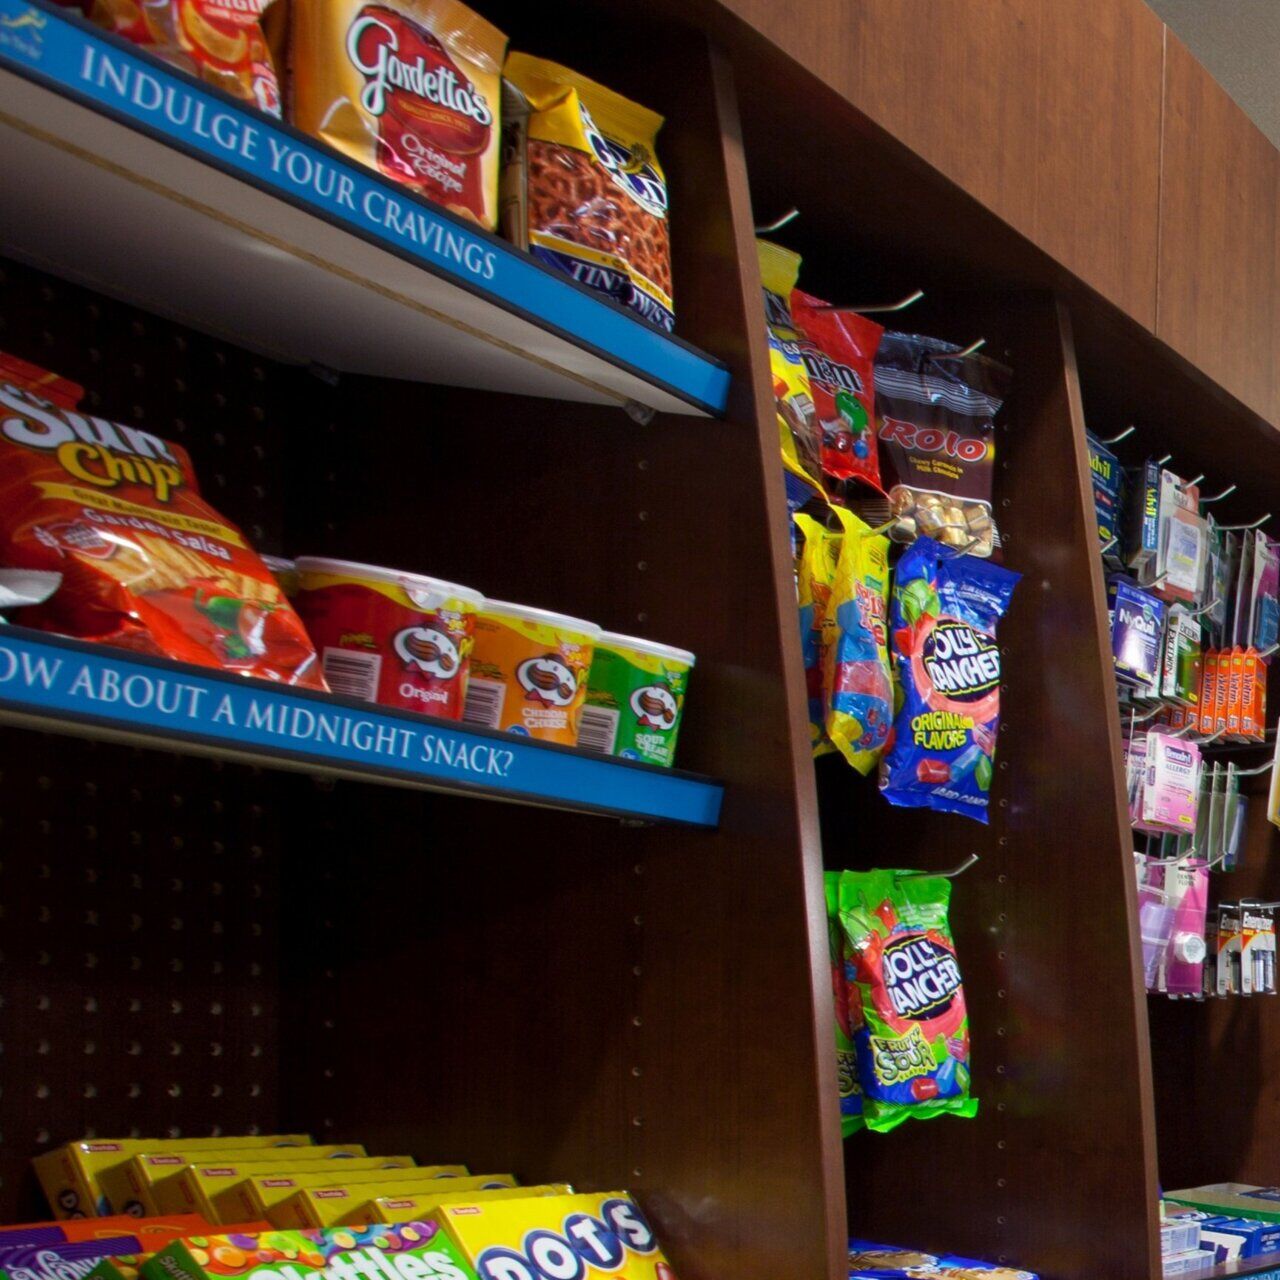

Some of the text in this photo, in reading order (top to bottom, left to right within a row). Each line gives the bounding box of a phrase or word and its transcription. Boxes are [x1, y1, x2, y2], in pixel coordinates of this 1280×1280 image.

[346, 15, 493, 125] Gardetto's
[81, 43, 259, 162] INDULGE
[268, 136, 356, 213] YOUR
[363, 191, 497, 281] CRAVINGS
[400, 133, 468, 178] Original
[412, 152, 464, 194] Recipe
[0, 384, 178, 464] Sun
[83, 507, 172, 541] Garden
[171, 526, 233, 561] Salsa
[1118, 607, 1156, 635] NyQuil
[76, 657, 208, 722] ABOUT
[214, 698, 251, 726] A
[245, 702, 414, 760] MIDNIGHT
[420, 731, 514, 779] SNACK?
[913, 730, 968, 750] FLAVORS
[876, 1041, 937, 1081] SOUR
